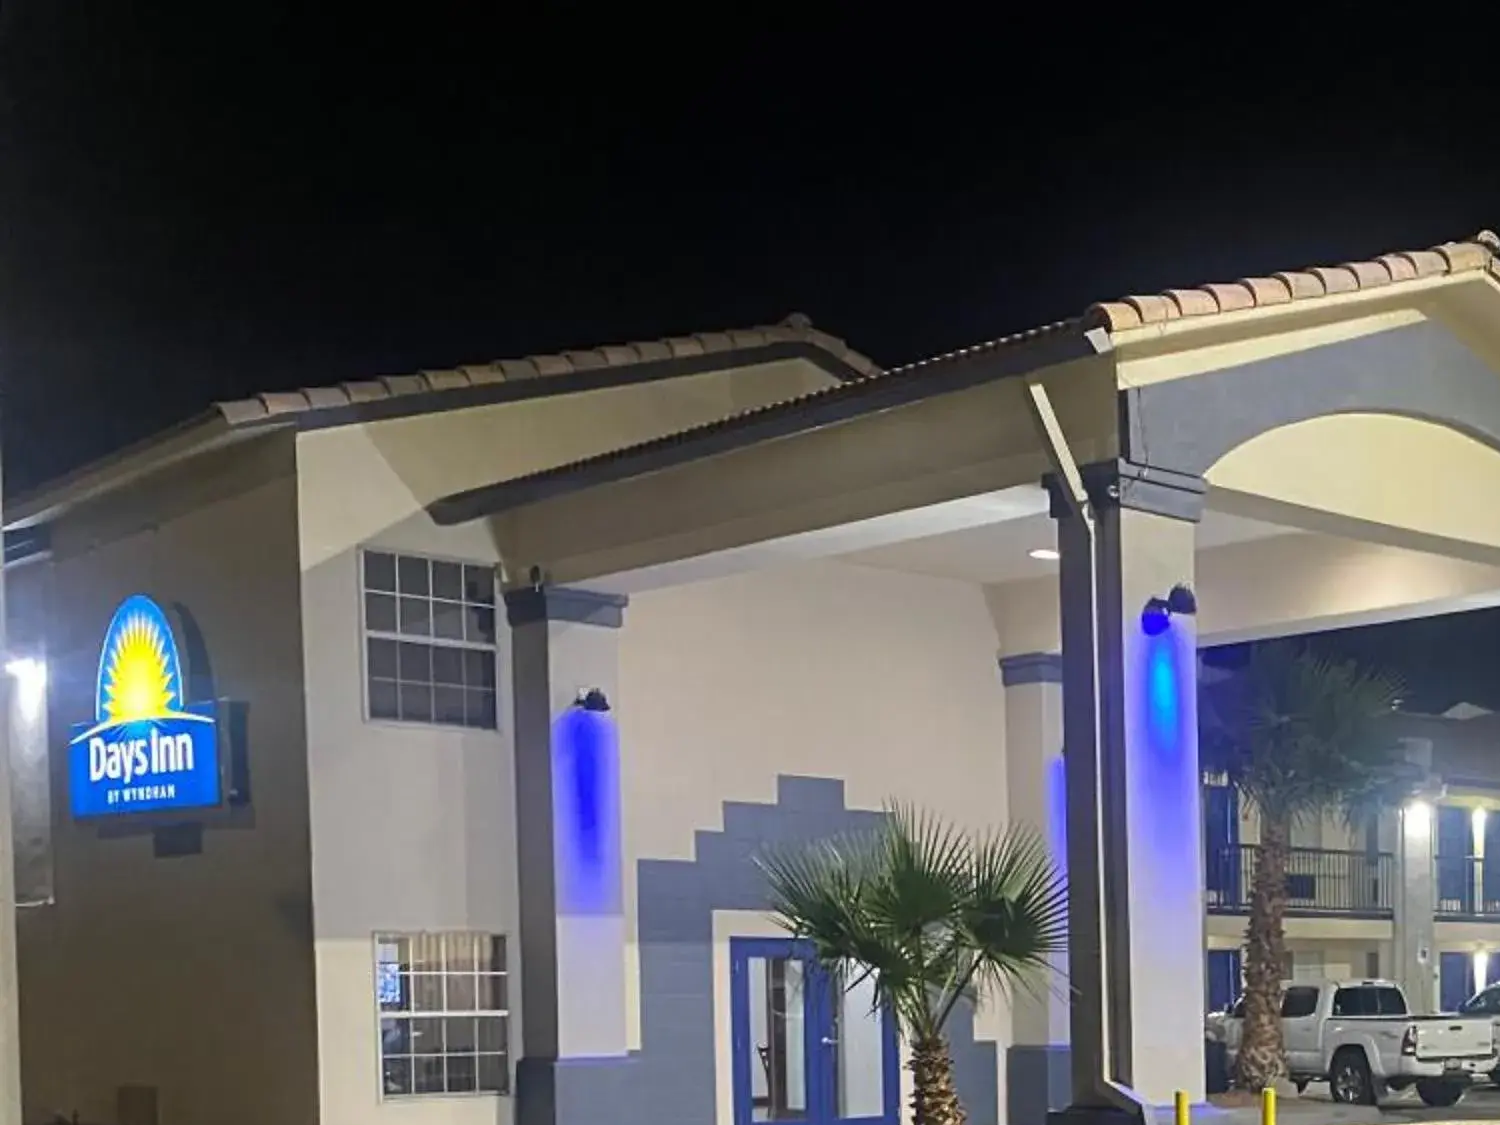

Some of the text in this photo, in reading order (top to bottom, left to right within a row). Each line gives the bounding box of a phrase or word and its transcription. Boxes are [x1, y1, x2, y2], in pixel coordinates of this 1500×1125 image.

[89, 728, 194, 783] Days Inn
[107, 789, 119, 804] BY
